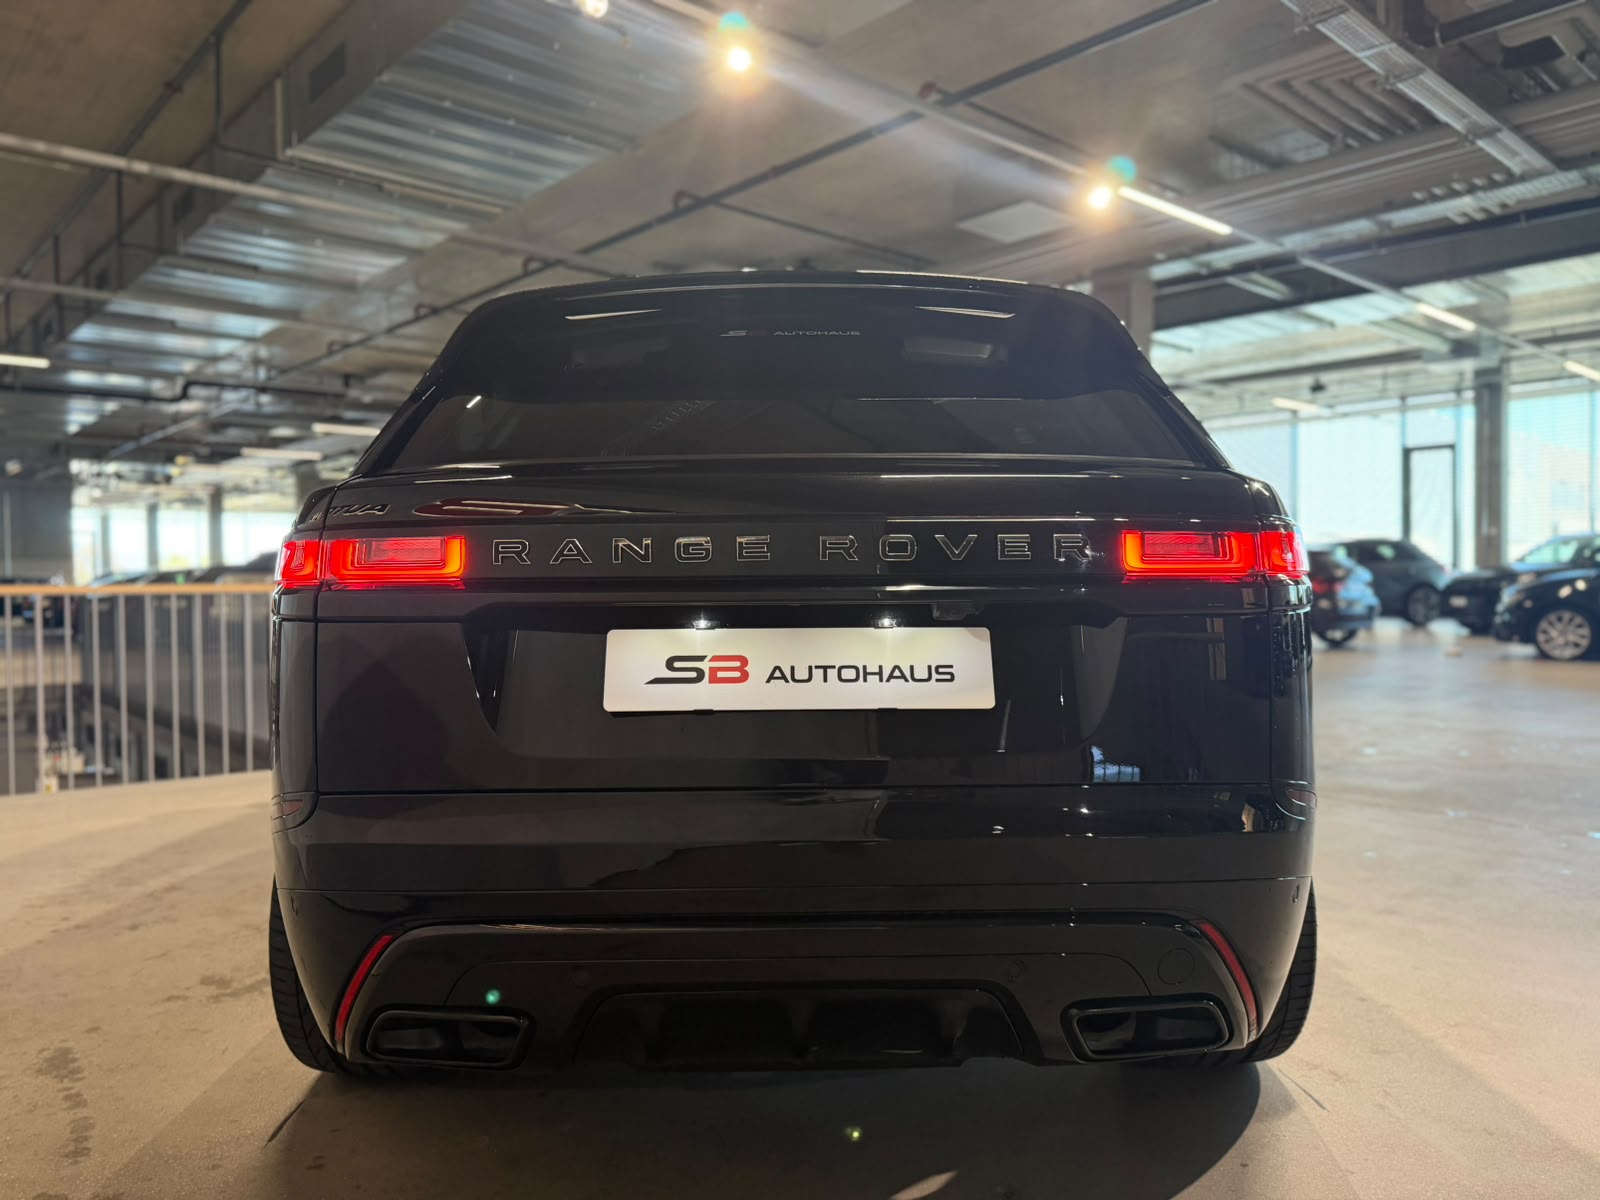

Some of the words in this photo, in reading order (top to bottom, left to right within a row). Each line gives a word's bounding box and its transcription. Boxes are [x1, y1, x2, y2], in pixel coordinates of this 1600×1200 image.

[492, 534, 771, 565] RANGE
[819, 533, 1093, 561] ROVER
[643, 654, 750, 685] SB
[765, 664, 956, 684] AUTOHAUS
